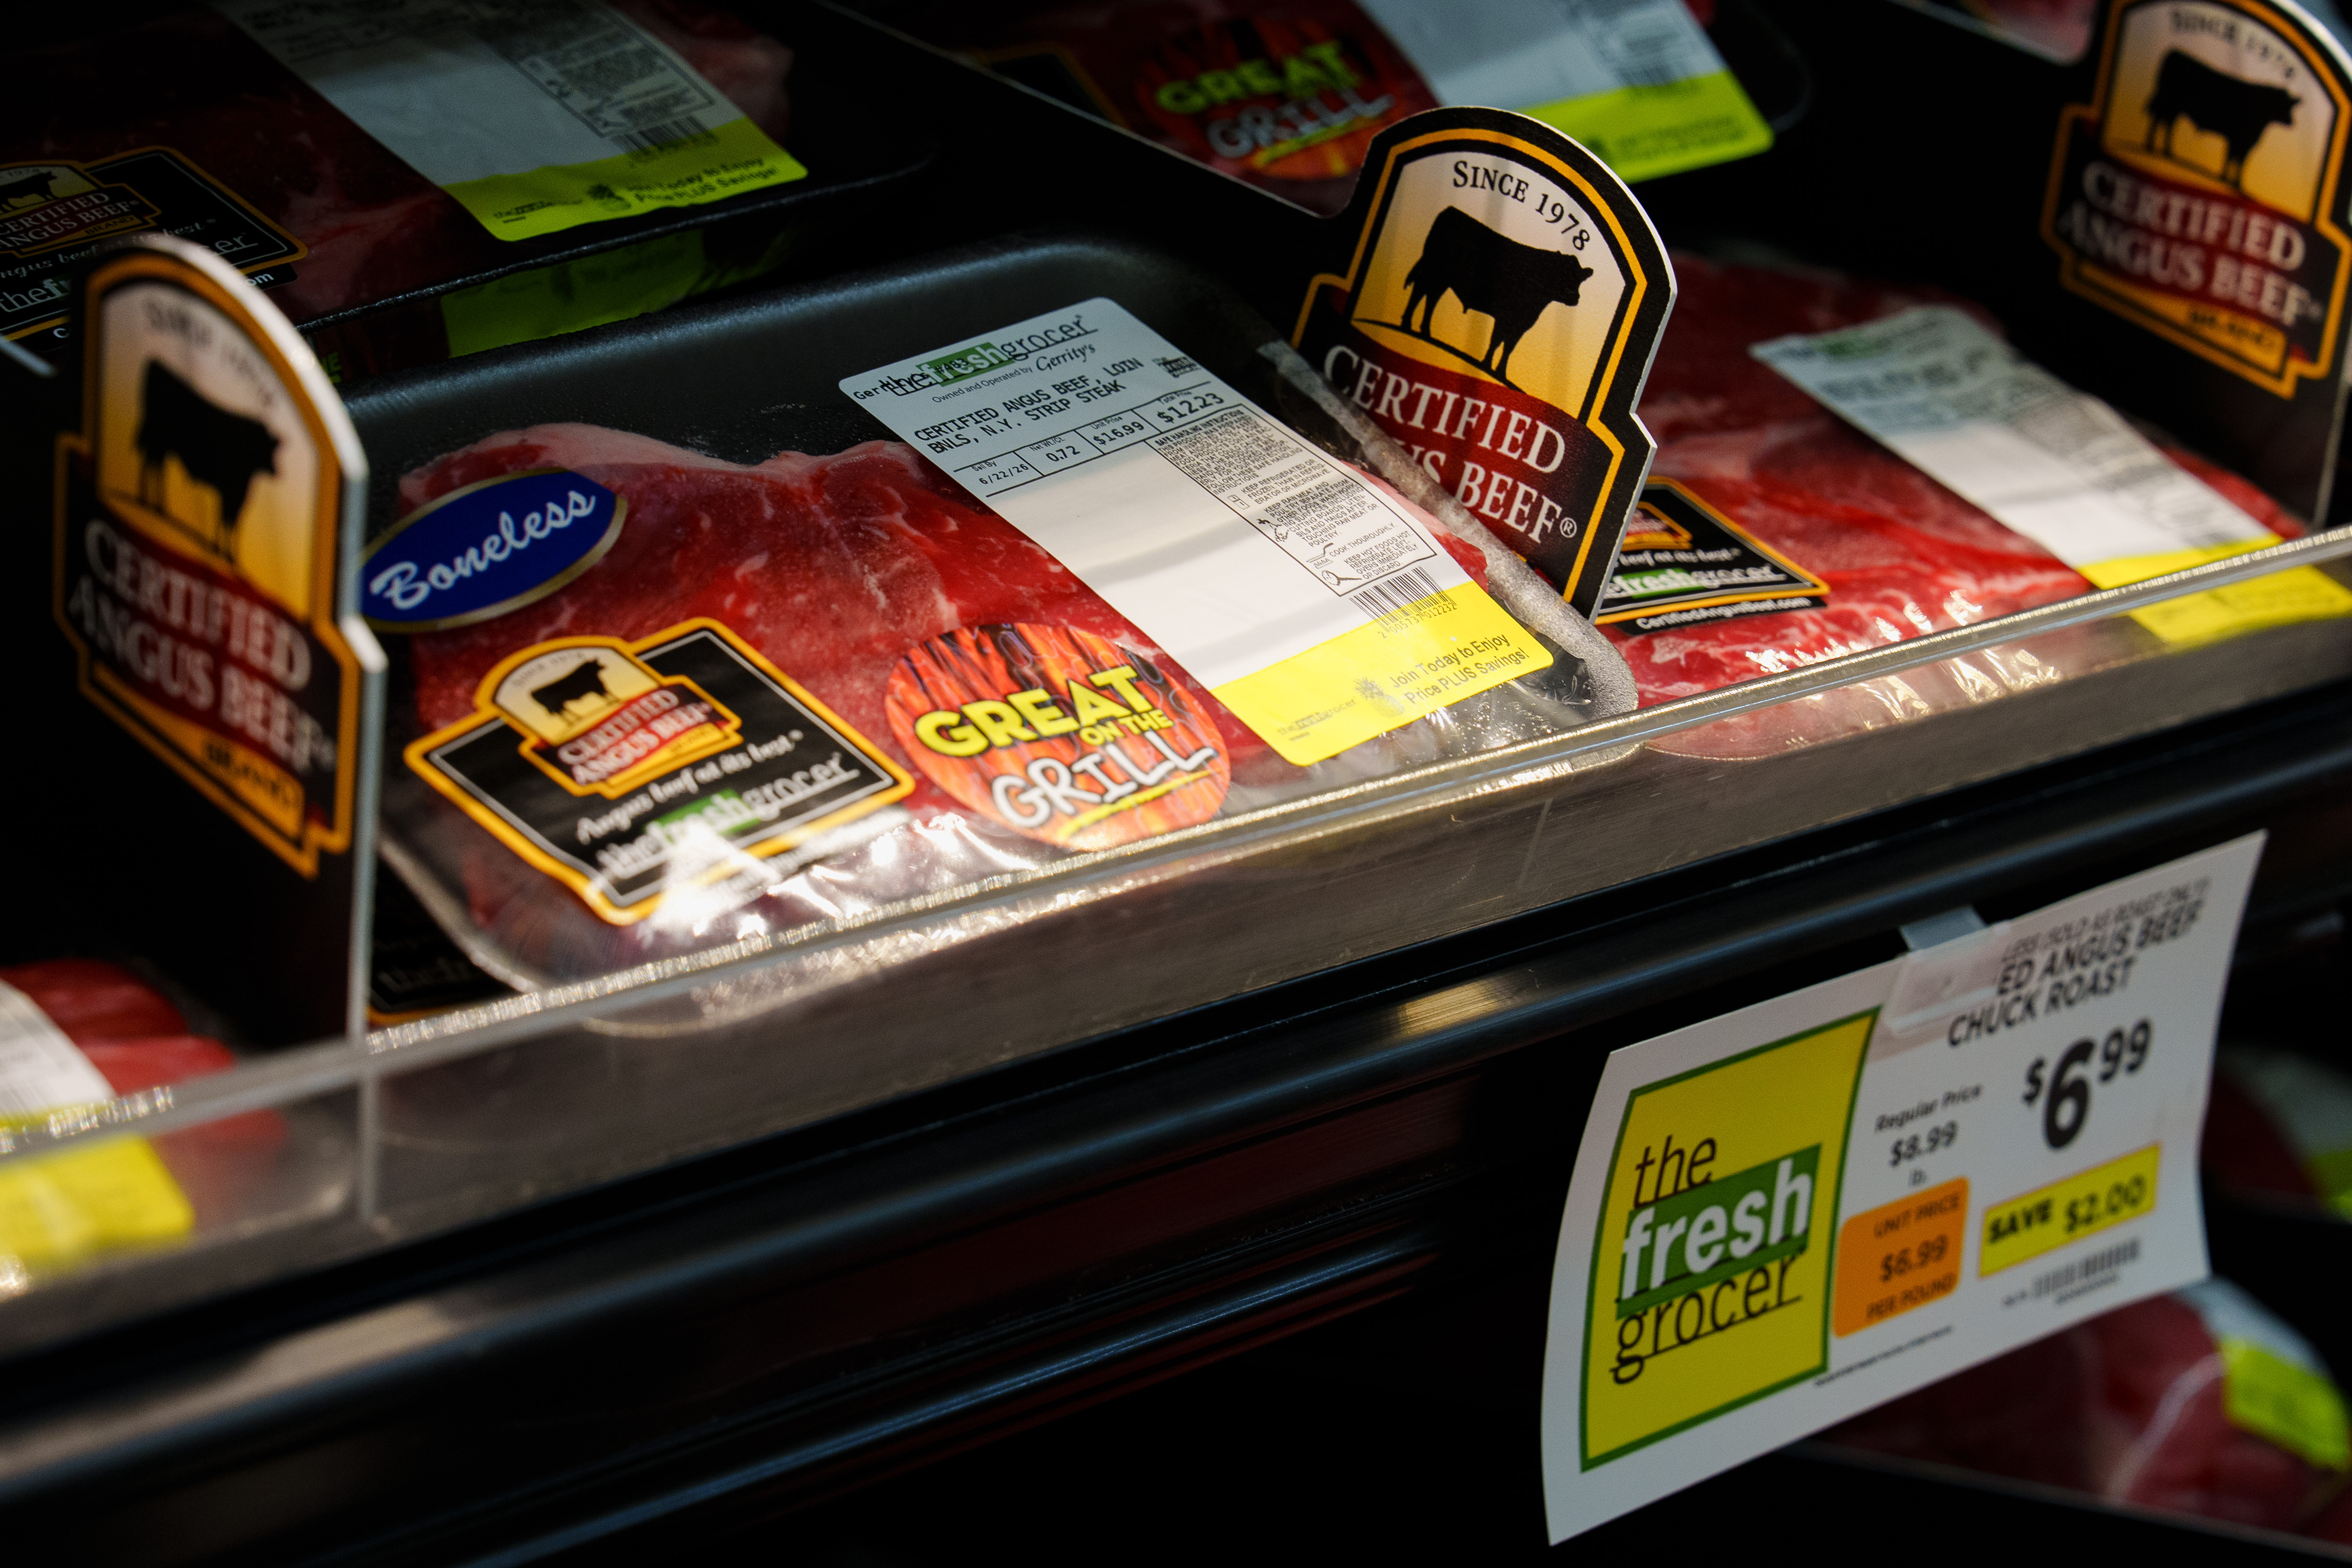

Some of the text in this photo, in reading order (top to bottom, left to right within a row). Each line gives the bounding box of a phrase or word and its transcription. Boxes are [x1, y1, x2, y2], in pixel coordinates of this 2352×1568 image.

[85, 216, 135, 235] BRAND
[1453, 160, 1591, 251] SINCE 1978
[2082, 161, 2306, 271] CERTIFIED
[2055, 199, 2206, 292] ANGUS
[932, 342, 1097, 403] Owned and Operated by Gerrity's
[914, 407, 1000, 441] CERTIFIED
[1002, 390, 1052, 412] ANGUS
[1102, 358, 1145, 377] LOIN
[927, 380, 1127, 454] BNLS, N.Y. STRIP STEAK
[1323, 343, 1566, 473] CERTIFIED
[971, 463, 986, 472] Sell
[1029, 441, 1041, 451] Net
[1090, 420, 1105, 430] Unit
[1105, 416, 1123, 425] Price
[979, 463, 1029, 484] 6/22/26
[1046, 446, 1081, 462] 0.72
[1093, 422, 1145, 446] $16.99
[1154, 425, 1202, 446] SAFE HANDLING
[1157, 433, 1204, 453] THIS PRODUCT
[1163, 433, 1219, 457] FROM INSPECTED
[1175, 442, 1230, 467] FOOD PRODUCTS
[1168, 452, 1190, 462] MEAT
[1181, 461, 1203, 472] TERIA
[1200, 454, 1220, 464] THAT
[1217, 445, 1242, 456] COULD
[1187, 466, 1208, 476] NESS
[1211, 457, 1227, 466] THE
[1224, 446, 1257, 461] PRODUCT
[1193, 465, 1227, 481] HANDLED
[1233, 450, 1263, 464] COOKED
[1206, 447, 1303, 490] FOLLOW THESE SAFE HANDLING
[1217, 469, 1235, 478] FOR
[1232, 462, 1252, 471] YOUR
[1211, 472, 1263, 495] INSTRUCTIONS.
[1240, 483, 1262, 493] KEEP
[1256, 462, 1309, 486] REFRIGERATED
[1253, 489, 1284, 504] ERATOR
[1263, 481, 1331, 513] KEEP RAW MEAT AND
[1274, 476, 1295, 487] THAW
[1268, 478, 1351, 518] POULTRY SEPARATE FROM
[1275, 510, 1300, 523] OTHER
[1317, 492, 1341, 503] WASH
[1281, 486, 1367, 527] ING SURFACES (INCLUDING
[1287, 517, 1319, 532] CUTTING
[1294, 500, 1369, 537] SILS AND HANDS AFTER
[1300, 523, 1339, 542] TOUCHING
[1334, 517, 1351, 526] RAW
[1347, 508, 1370, 520] MEAT
[1306, 529, 1343, 547] POULTRY.
[370, 490, 596, 610] Boneless
[1327, 544, 1351, 557] COOK
[1343, 536, 1400, 565] KEEP HOT FOODS
[1348, 547, 1395, 569] REFRIGERATE
[1355, 542, 1421, 574] OVERS IMMEDIATELY
[1371, 559, 1404, 575] DISCARD.
[85, 518, 311, 691] CERTIFIED
[1389, 613, 1424, 633] 005737
[1423, 602, 1457, 619] 012232
[69, 573, 215, 710] ANGUS
[1390, 634, 1511, 689] Join Today to Enjoy
[1404, 647, 1530, 704] Price PLUS Savings!
[914, 665, 1154, 756] GREAT
[1081, 709, 1175, 746] ON THE
[992, 730, 1219, 828] GRILL
[2038, 922, 2131, 982] ANGUS
[2137, 898, 2205, 949] BEEF
[1948, 989, 2042, 1048] CHUCK
[2044, 955, 2136, 1015] ROAST
[1874, 1083, 1984, 1133] Regular Price
[1887, 1119, 1960, 1168] $8.99
[1635, 1134, 1716, 1209] the
[1915, 1193, 1961, 1221] PRICE
[1988, 1175, 2148, 1246] SAVE $2.00
[1621, 1158, 1812, 1303] fresh
[1880, 1234, 1949, 1284] $6.99
[1866, 1273, 1957, 1319] PER POUND
[1609, 1248, 1804, 1385] grocer
